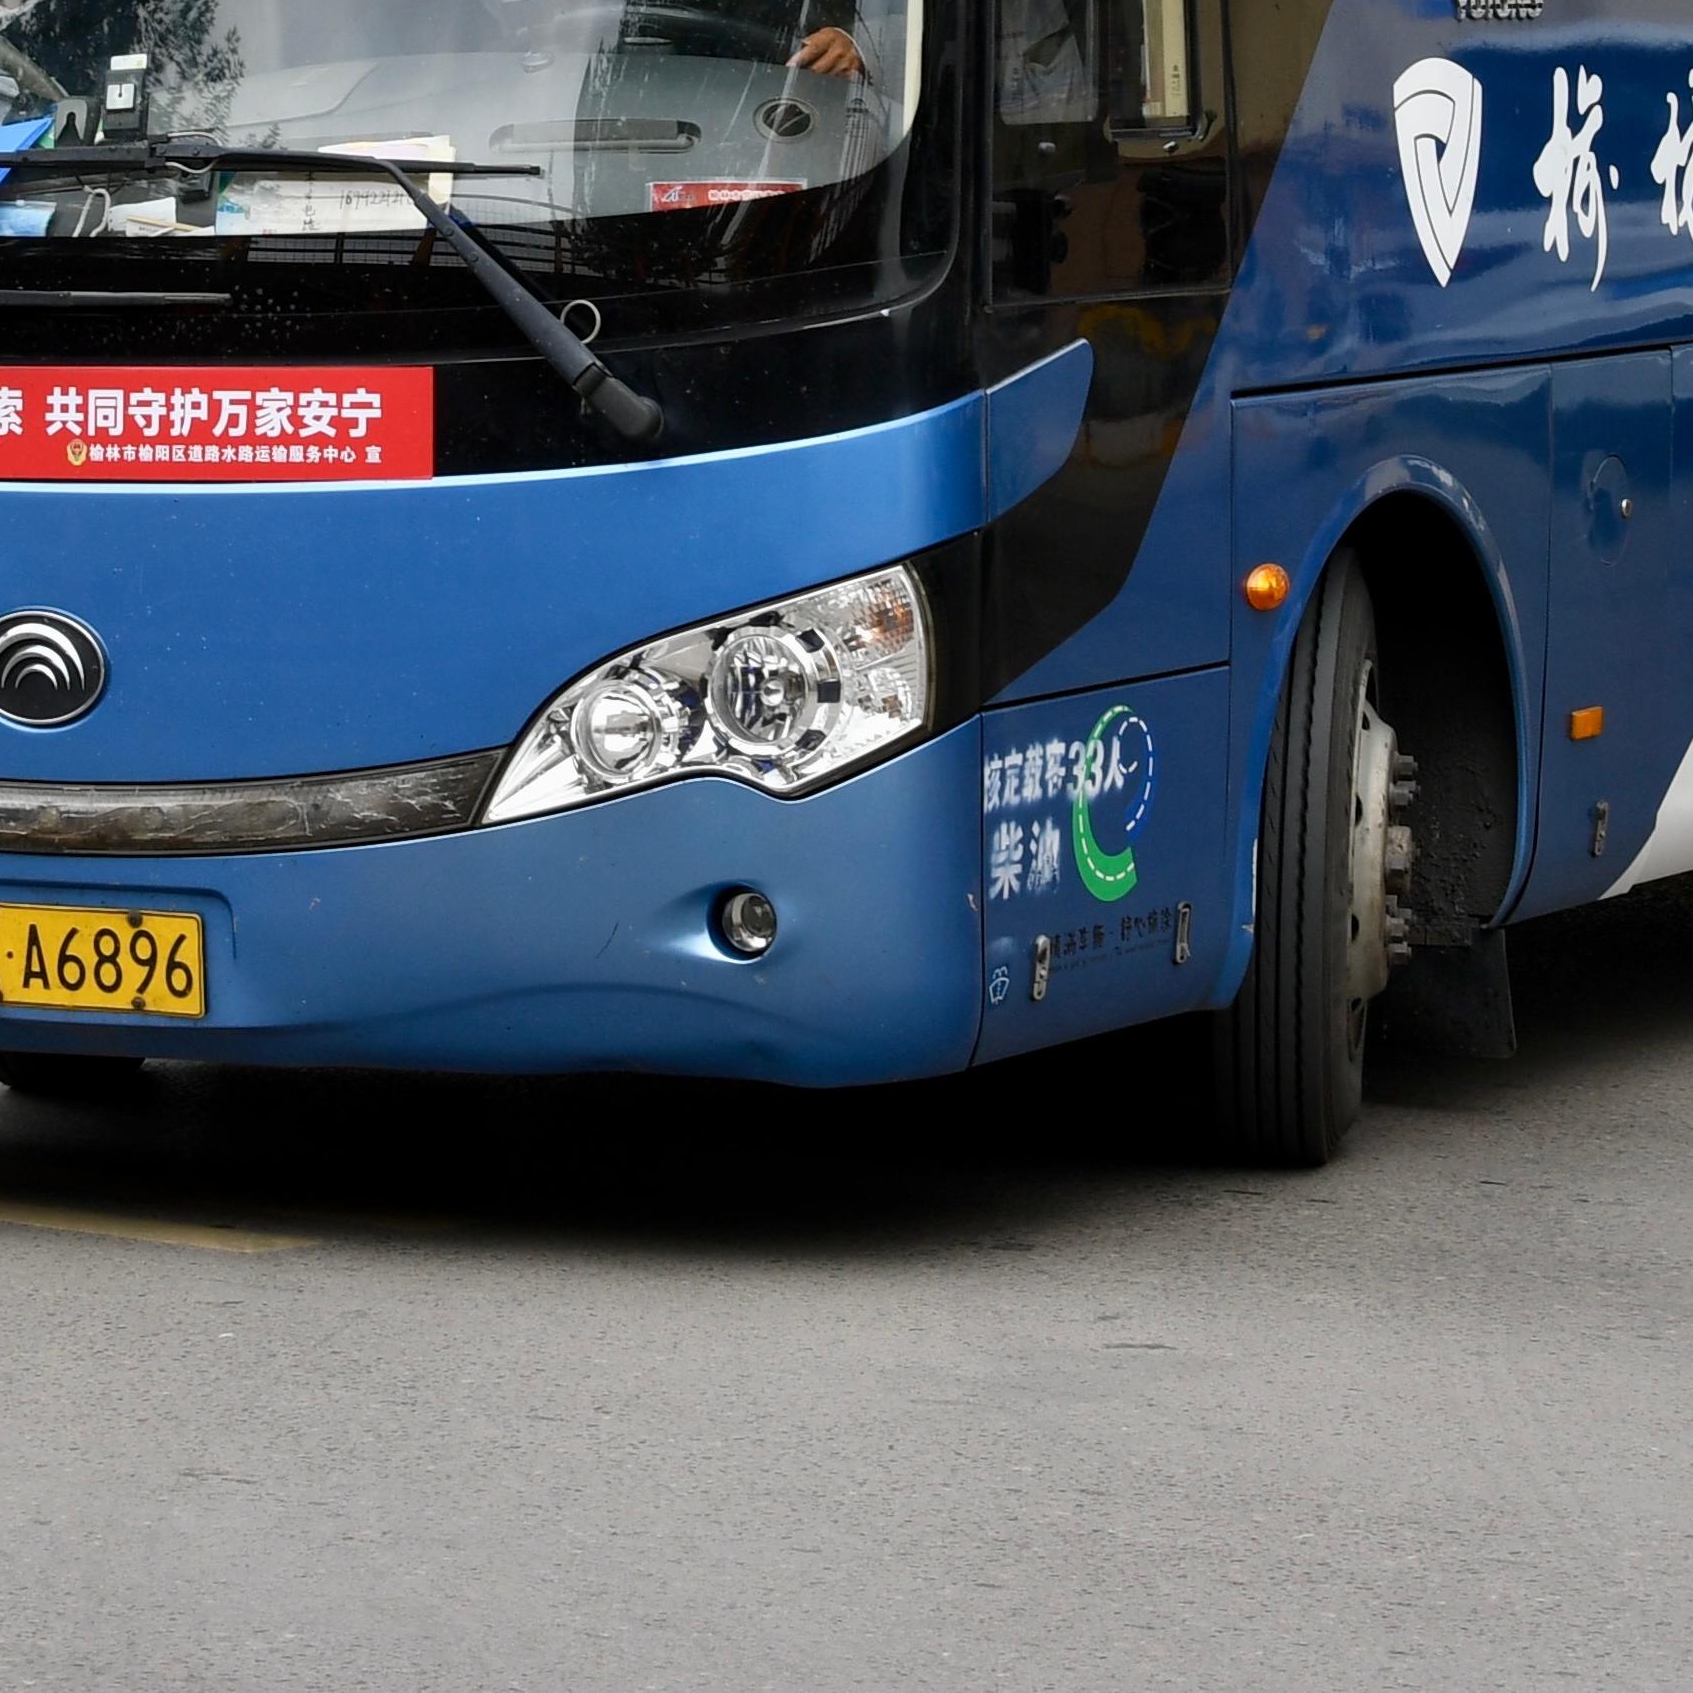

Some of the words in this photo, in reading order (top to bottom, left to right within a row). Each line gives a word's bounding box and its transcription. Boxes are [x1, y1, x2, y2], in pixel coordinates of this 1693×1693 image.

[45, 386, 382, 439] 共同守护万家安宁
[89, 442, 357, 464] 榆林市榆阳区道路水路运输服务中心
[364, 445, 383, 465] 宣
